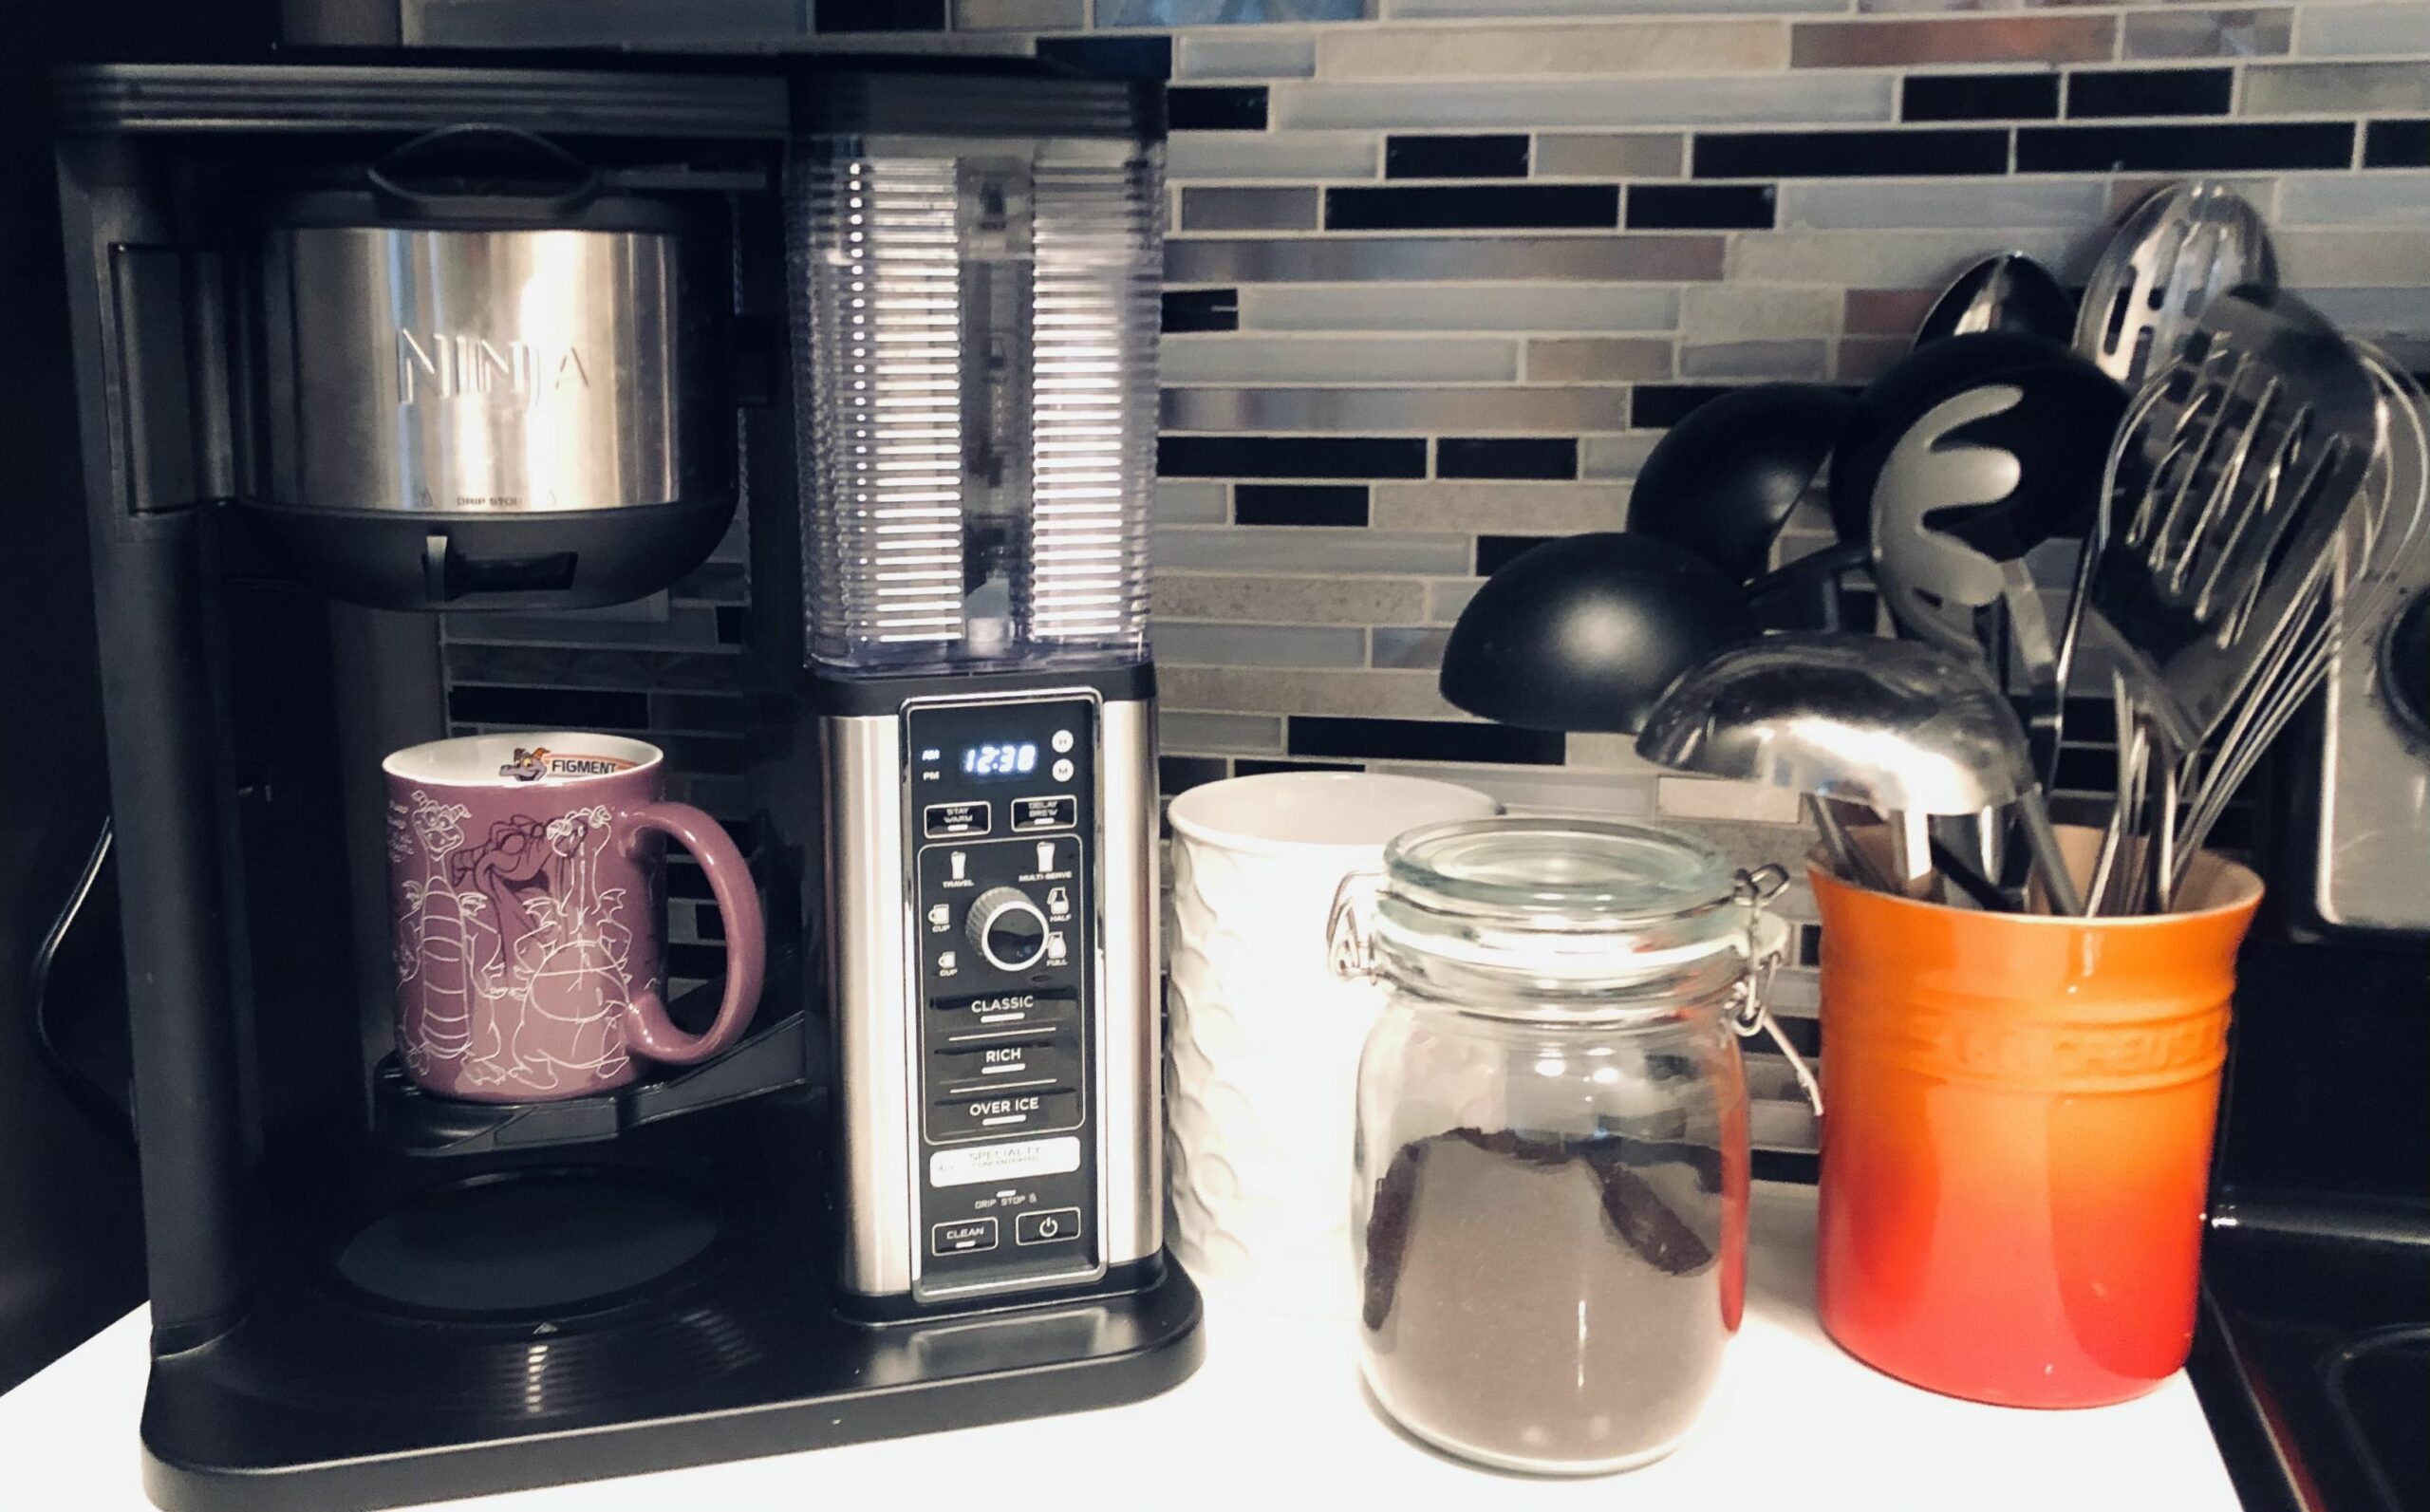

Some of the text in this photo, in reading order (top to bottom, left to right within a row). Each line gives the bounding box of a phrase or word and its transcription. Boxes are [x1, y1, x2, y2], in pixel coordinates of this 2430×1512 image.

[397, 328, 589, 413] NINJA
[965, 745, 1037, 773] 12:30
[552, 760, 616, 774] FIGMENT
[923, 771, 940, 780] PM
[1028, 801, 1058, 810] DELAY
[944, 815, 973, 824] WARM
[1029, 810, 1058, 818] BREW
[1019, 871, 1073, 882] MULTI-SERVE
[943, 880, 974, 888] TRAVEL
[1049, 914, 1072, 923] HALF
[932, 924, 950, 933] CUP
[940, 968, 958, 977] CUP
[971, 996, 1034, 1013] CLASSIC
[985, 1048, 1021, 1062] RICH
[969, 1097, 1038, 1116] OVER ICE
[975, 1195, 1025, 1209] DRIP STOP
[946, 1227, 984, 1240] CLEAN
